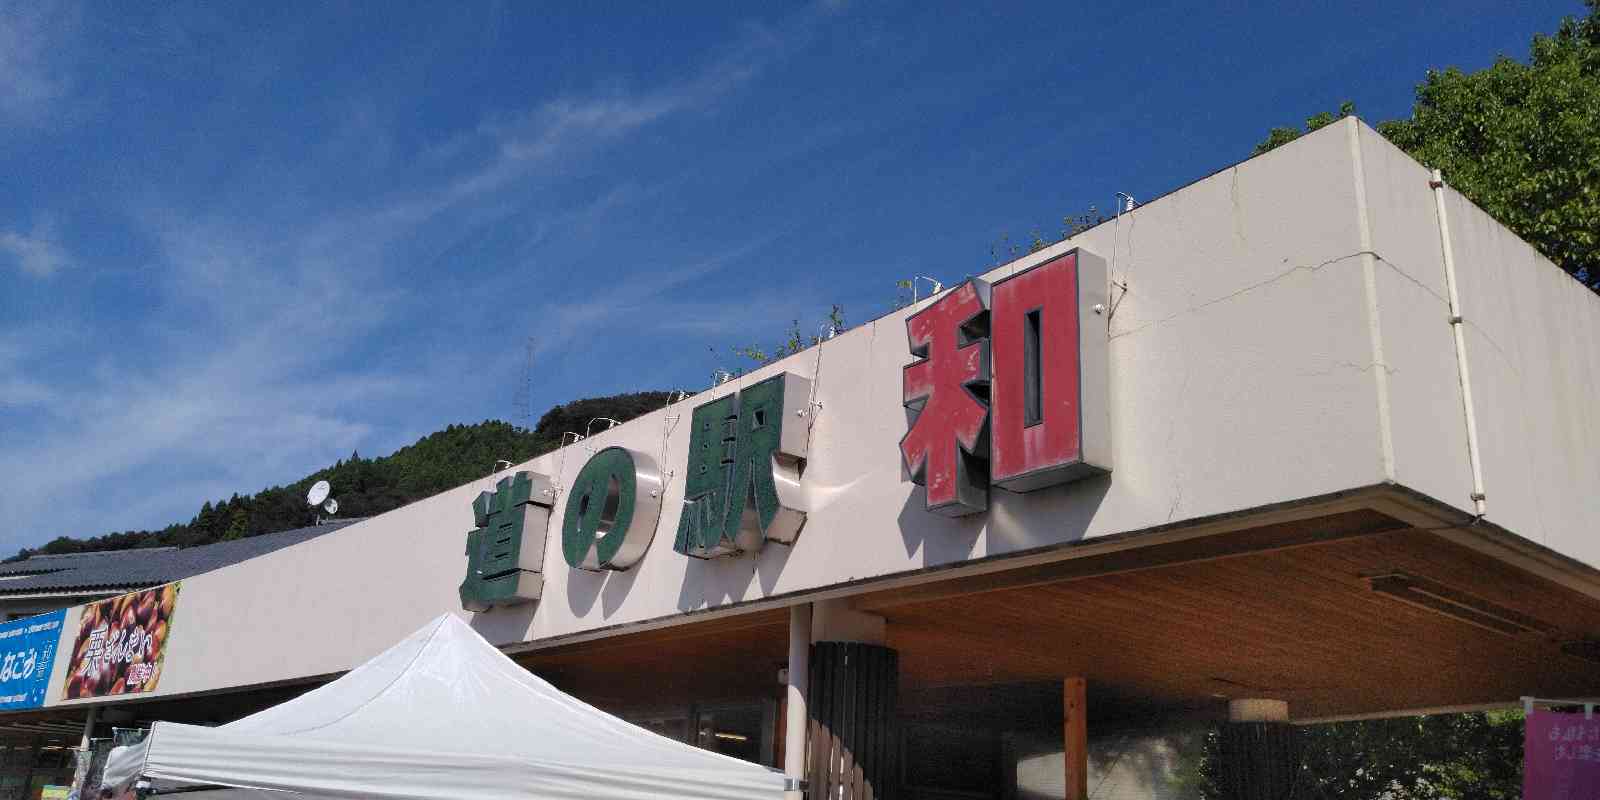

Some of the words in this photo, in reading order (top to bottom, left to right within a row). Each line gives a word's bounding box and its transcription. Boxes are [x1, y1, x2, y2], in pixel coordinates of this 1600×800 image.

[459, 372, 790, 608] 道の駅
[899, 247, 1090, 511] 和
